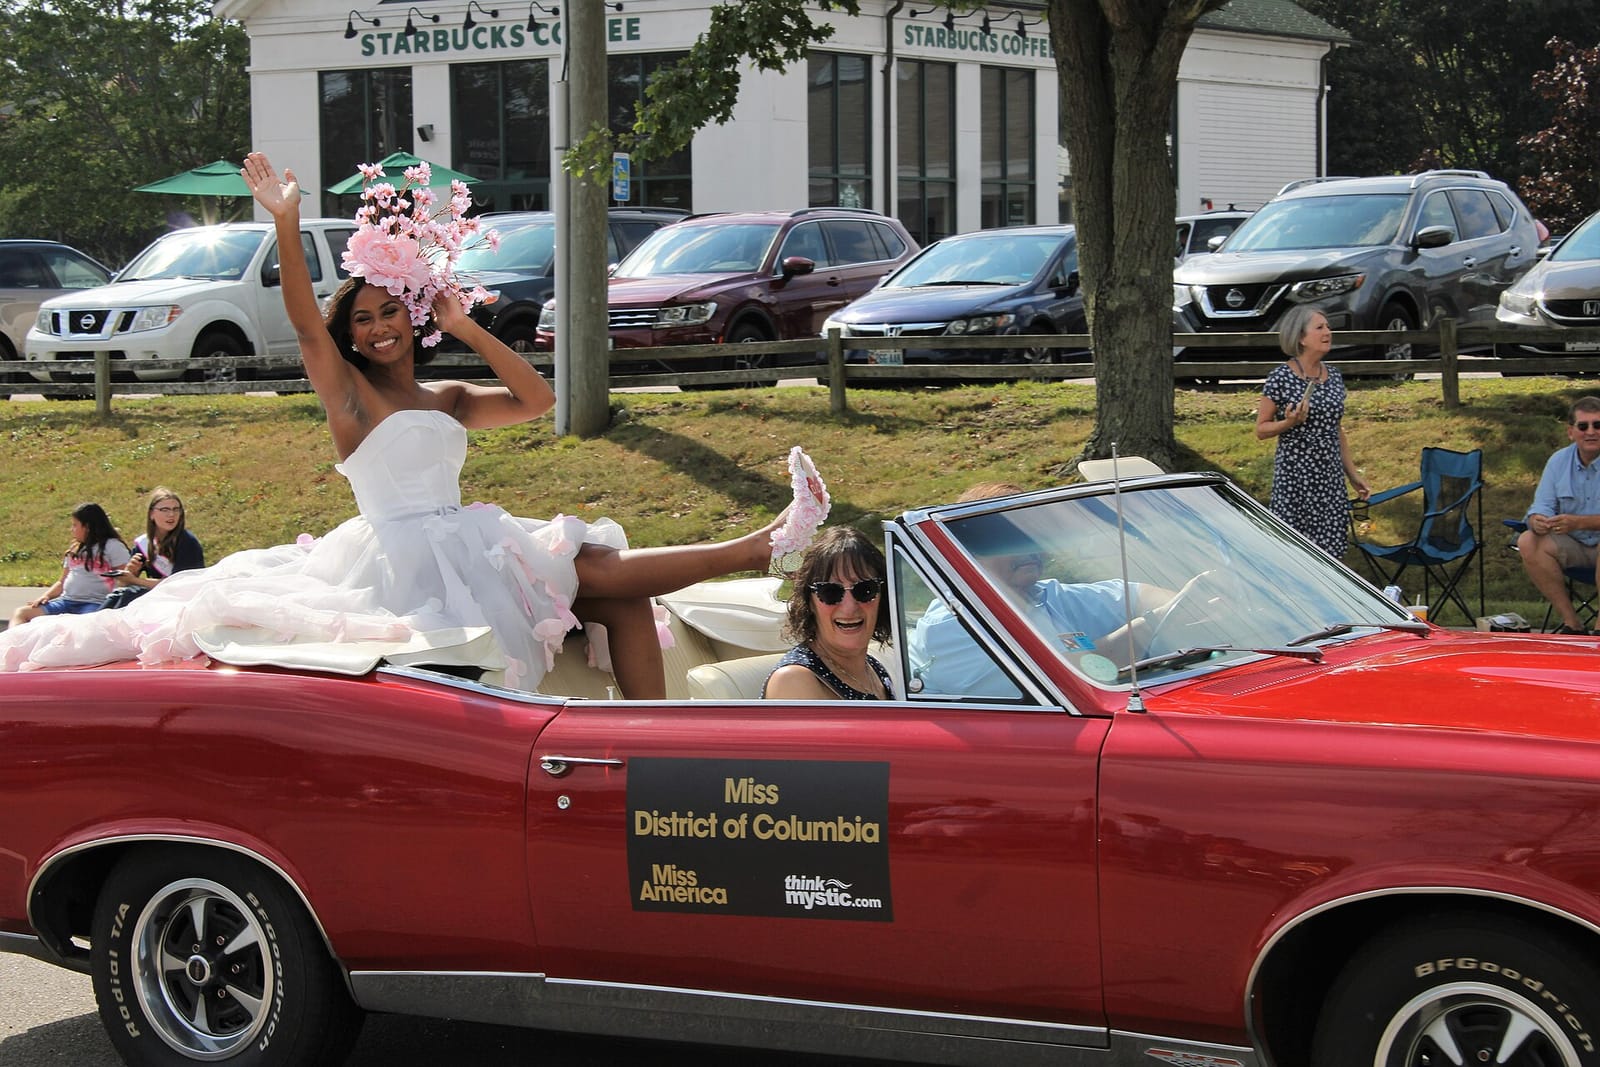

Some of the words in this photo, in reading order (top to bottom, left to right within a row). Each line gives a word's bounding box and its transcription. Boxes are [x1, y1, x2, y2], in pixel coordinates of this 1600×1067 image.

[361, 23, 525, 56] STARBUCKS
[532, 17, 641, 46] CEE
[904, 24, 998, 53] STARBUCKS
[725, 777, 779, 805] Miss
[634, 810, 718, 838] District
[722, 813, 748, 839] of
[752, 813, 880, 843] Columbia
[652, 863, 698, 887] Miss
[784, 875, 826, 891] think
[640, 880, 728, 904] America
[785, 888, 882, 910] mystic.com
[110, 903, 130, 939] T/A
[246, 892, 284, 1051] BFGoodrich
[108, 950, 141, 1038] Radial
[1414, 957, 1595, 1052] BFGoodrich
